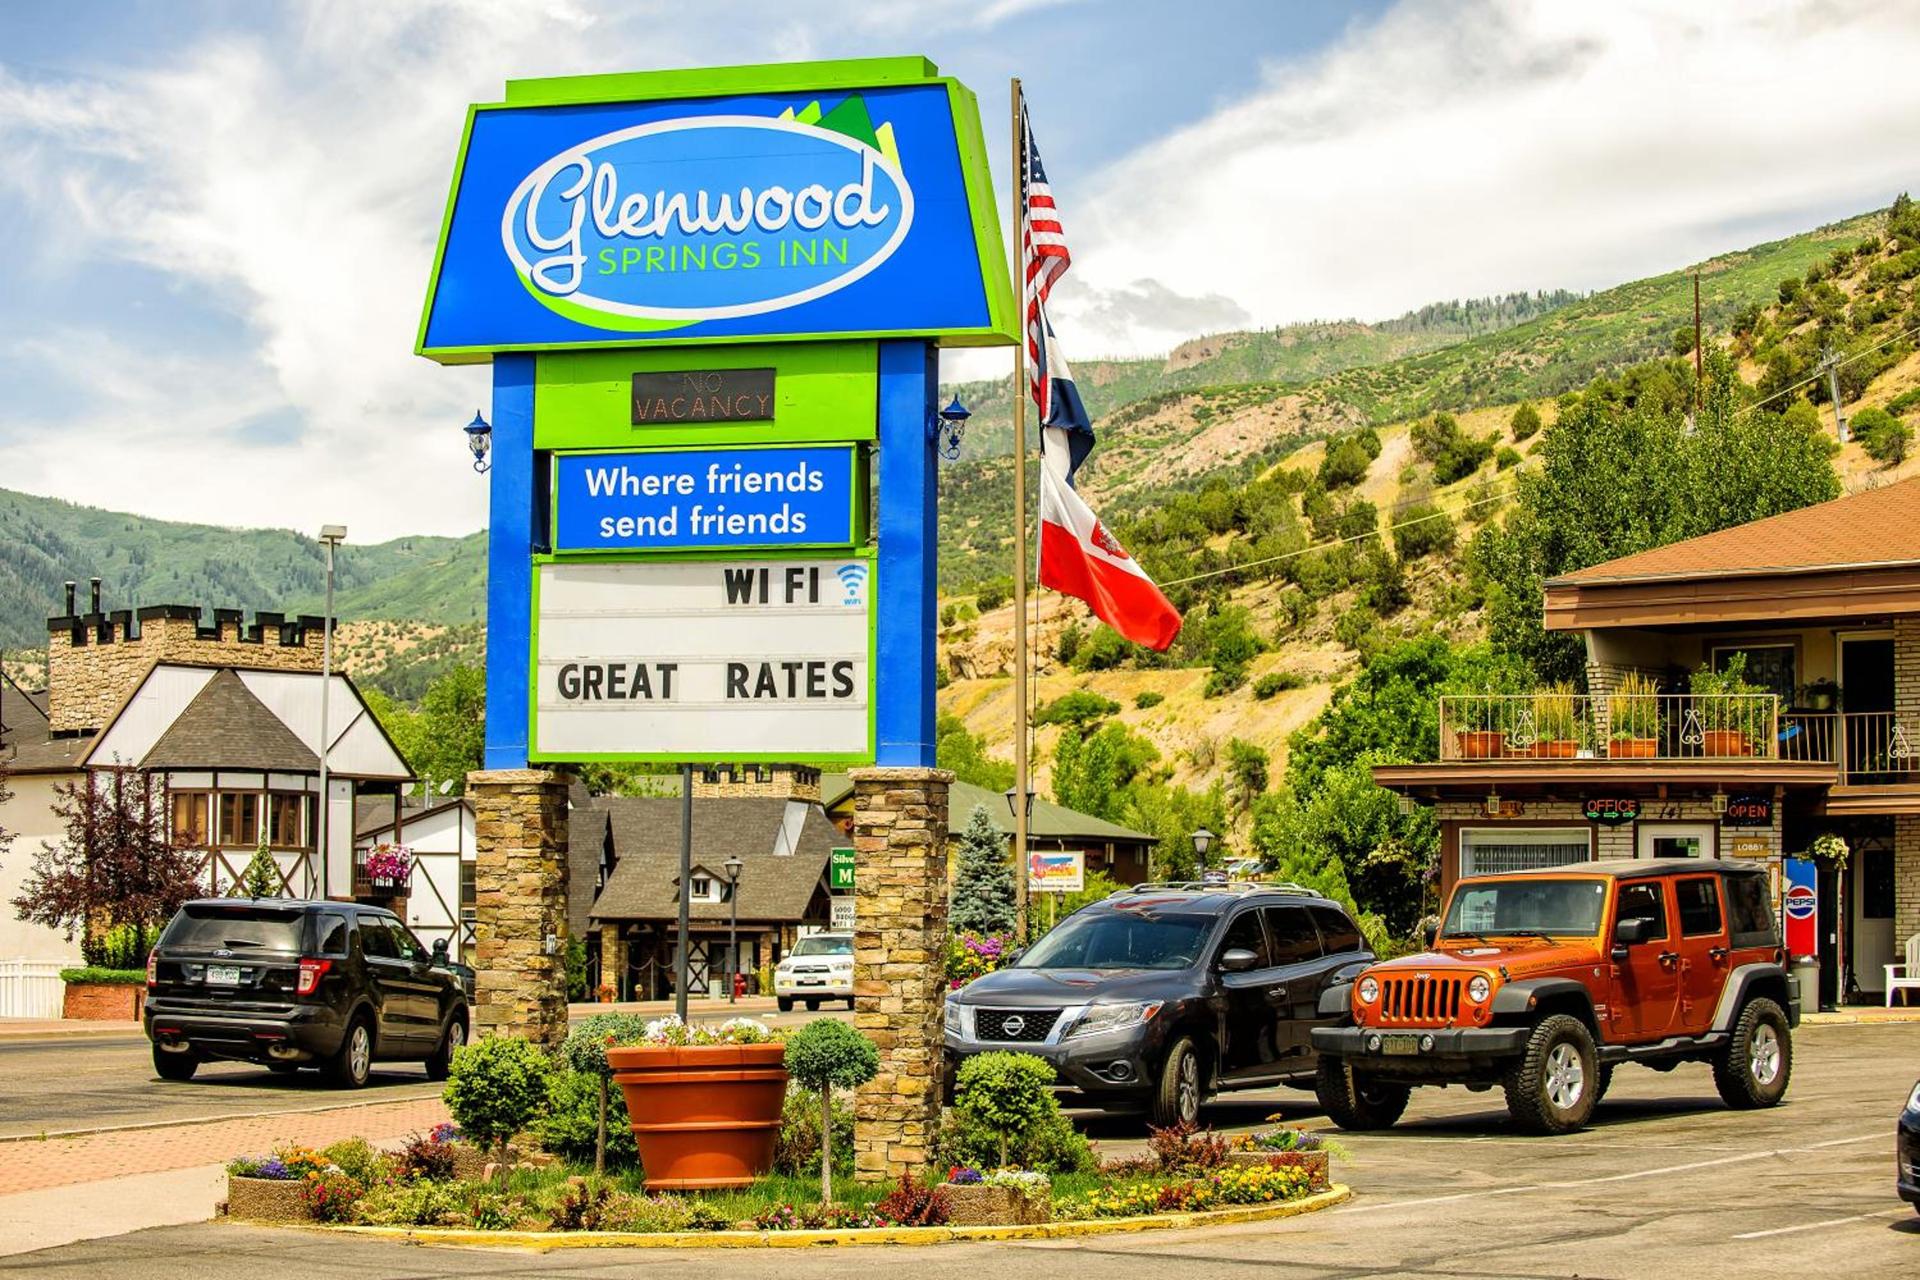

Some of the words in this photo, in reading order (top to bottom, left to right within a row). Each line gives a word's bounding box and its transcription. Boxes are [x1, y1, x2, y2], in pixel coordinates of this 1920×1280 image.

[526, 149, 890, 295] Glenwood
[597, 240, 762, 275] SPRINGS
[778, 237, 849, 268] INN
[683, 372, 723, 393] NO
[635, 394, 770, 420] VACANCY
[585, 465, 695, 497] Where
[706, 462, 824, 494] friends
[599, 505, 679, 538] send
[689, 502, 807, 536] friends
[557, 662, 678, 700] GREAT
[726, 660, 855, 699] RATES
[1587, 799, 1636, 812] OFFICE
[1728, 804, 1768, 818] OPEN
[1737, 843, 1764, 851] LOBBY
[839, 868, 855, 884] M
[1786, 898, 1816, 906] PEPSI
